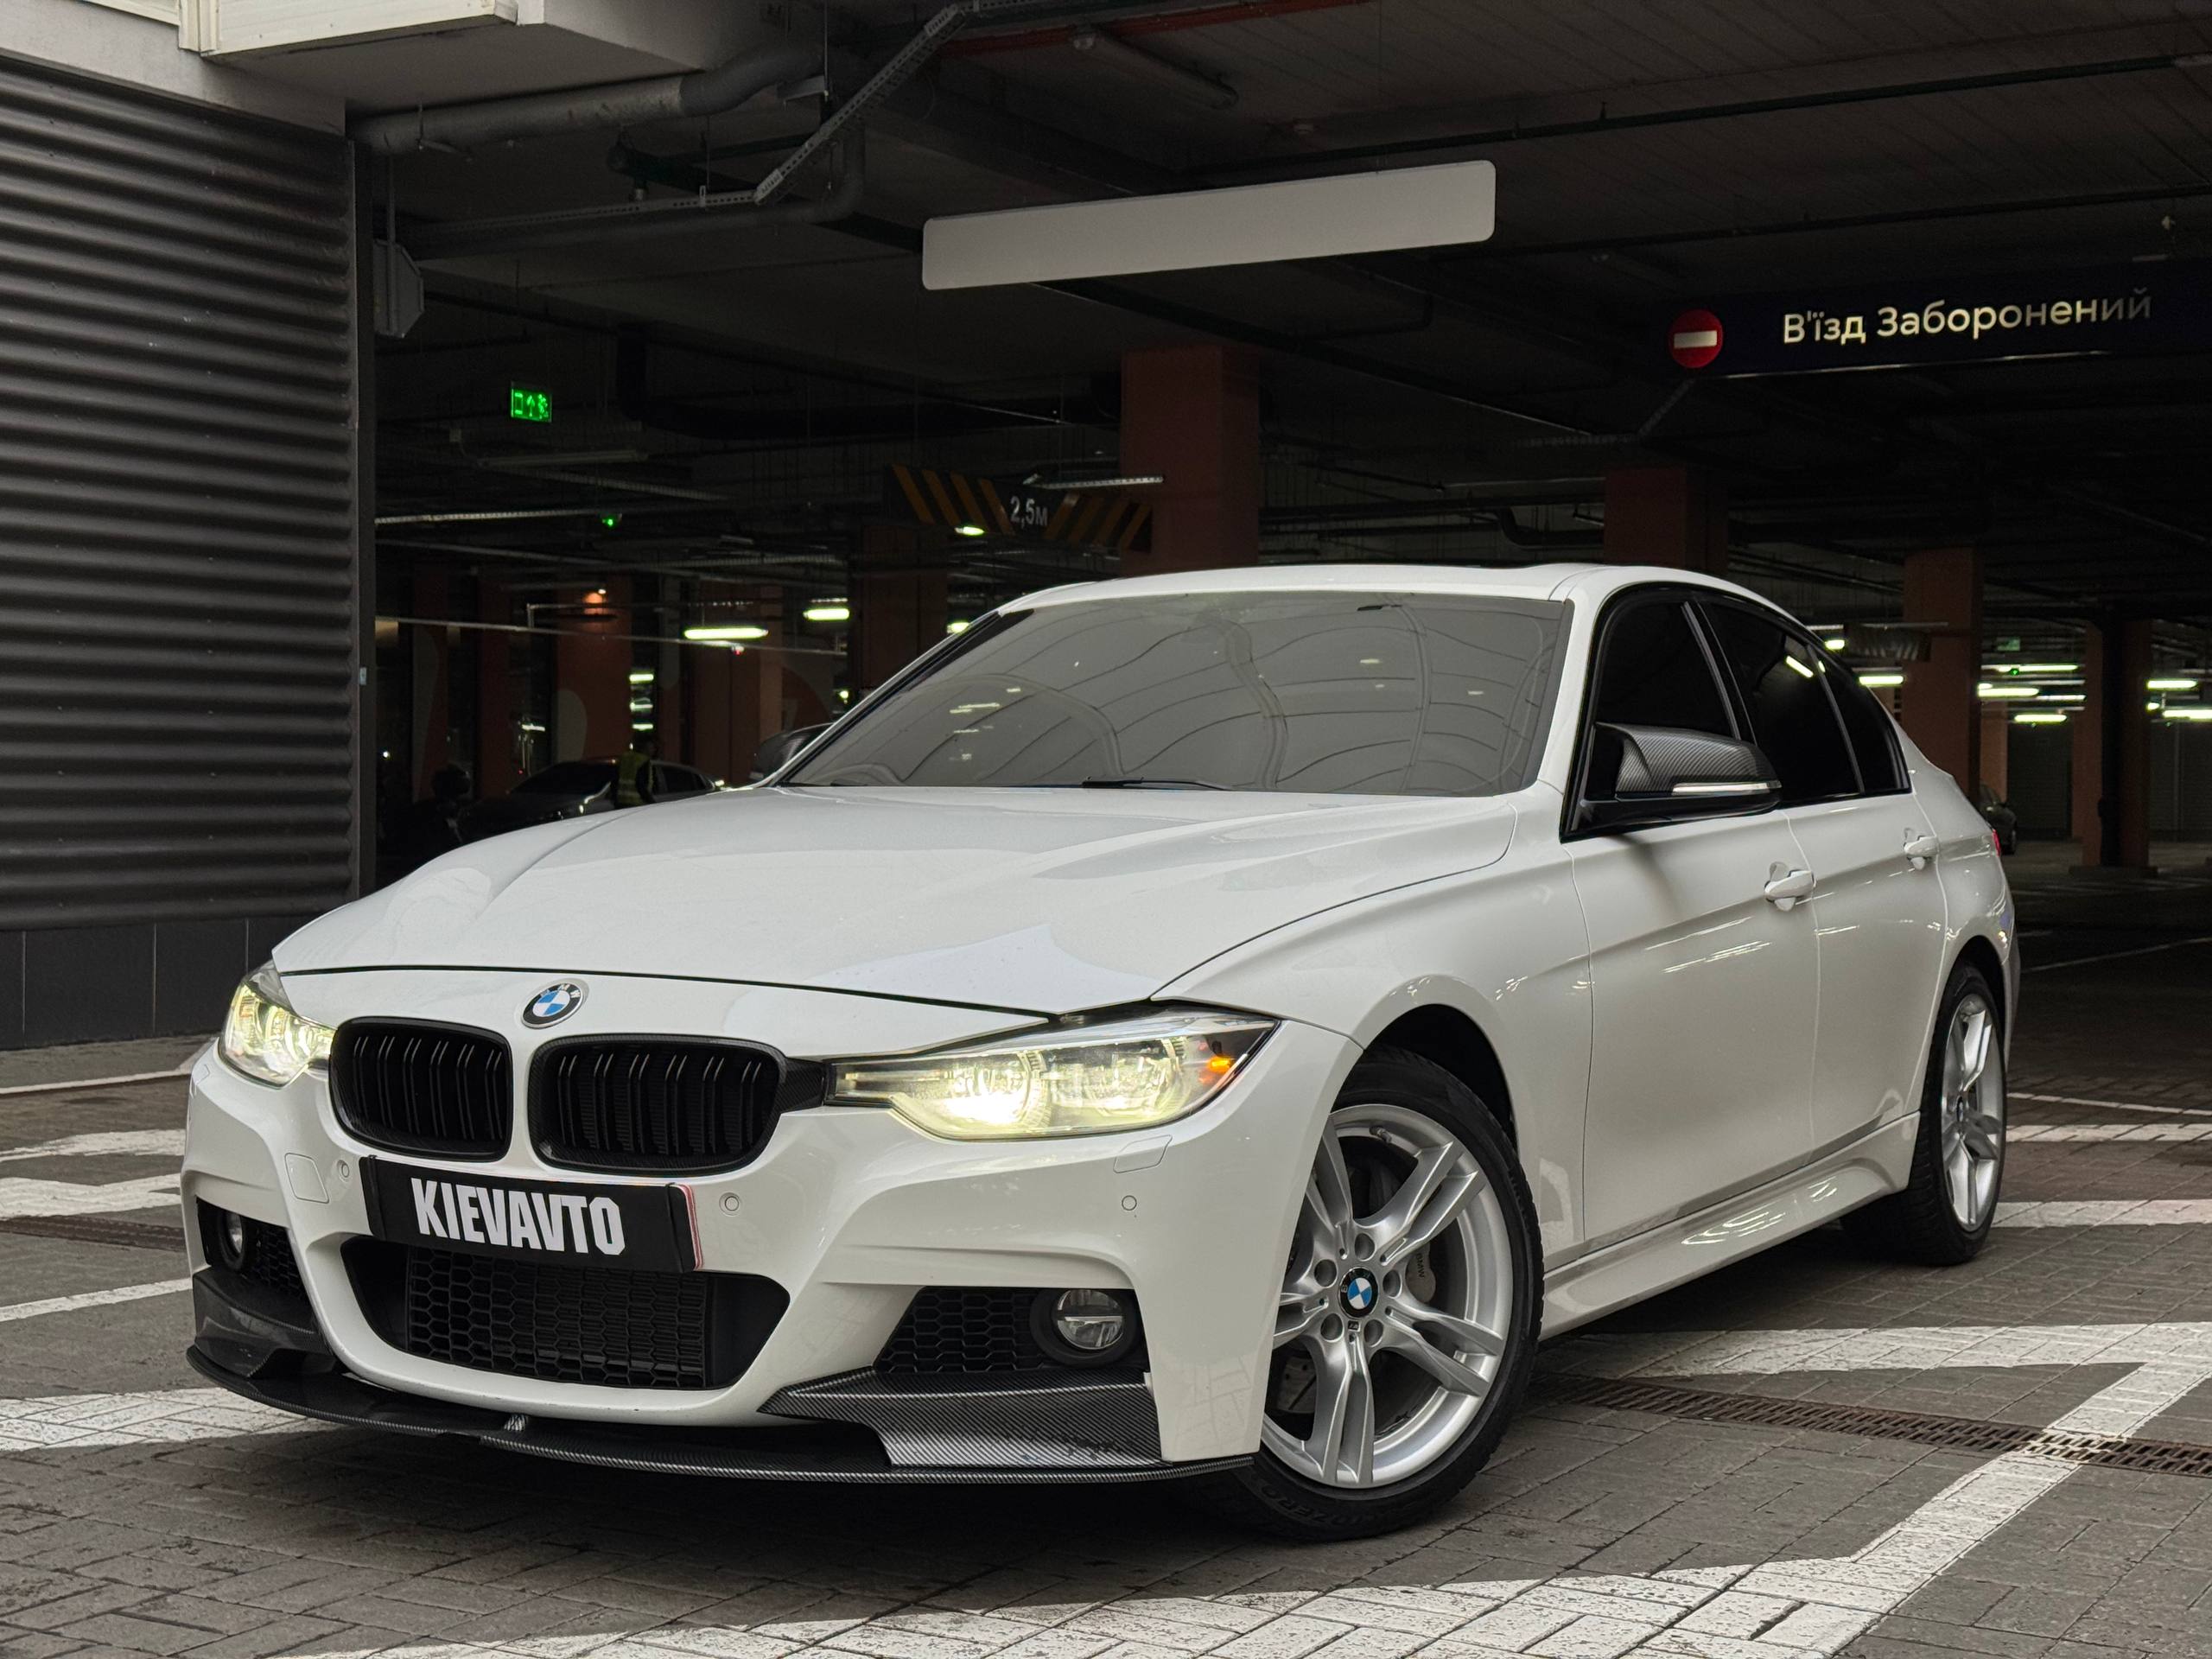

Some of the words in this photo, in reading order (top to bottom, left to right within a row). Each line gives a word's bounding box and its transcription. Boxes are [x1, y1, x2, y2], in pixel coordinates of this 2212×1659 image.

[1877, 288, 2152, 340] Заборонений
[539, 983, 581, 998] BMW
[410, 1178, 626, 1255] KIEVAVTO
[1416, 1252, 1425, 1278] BMW
